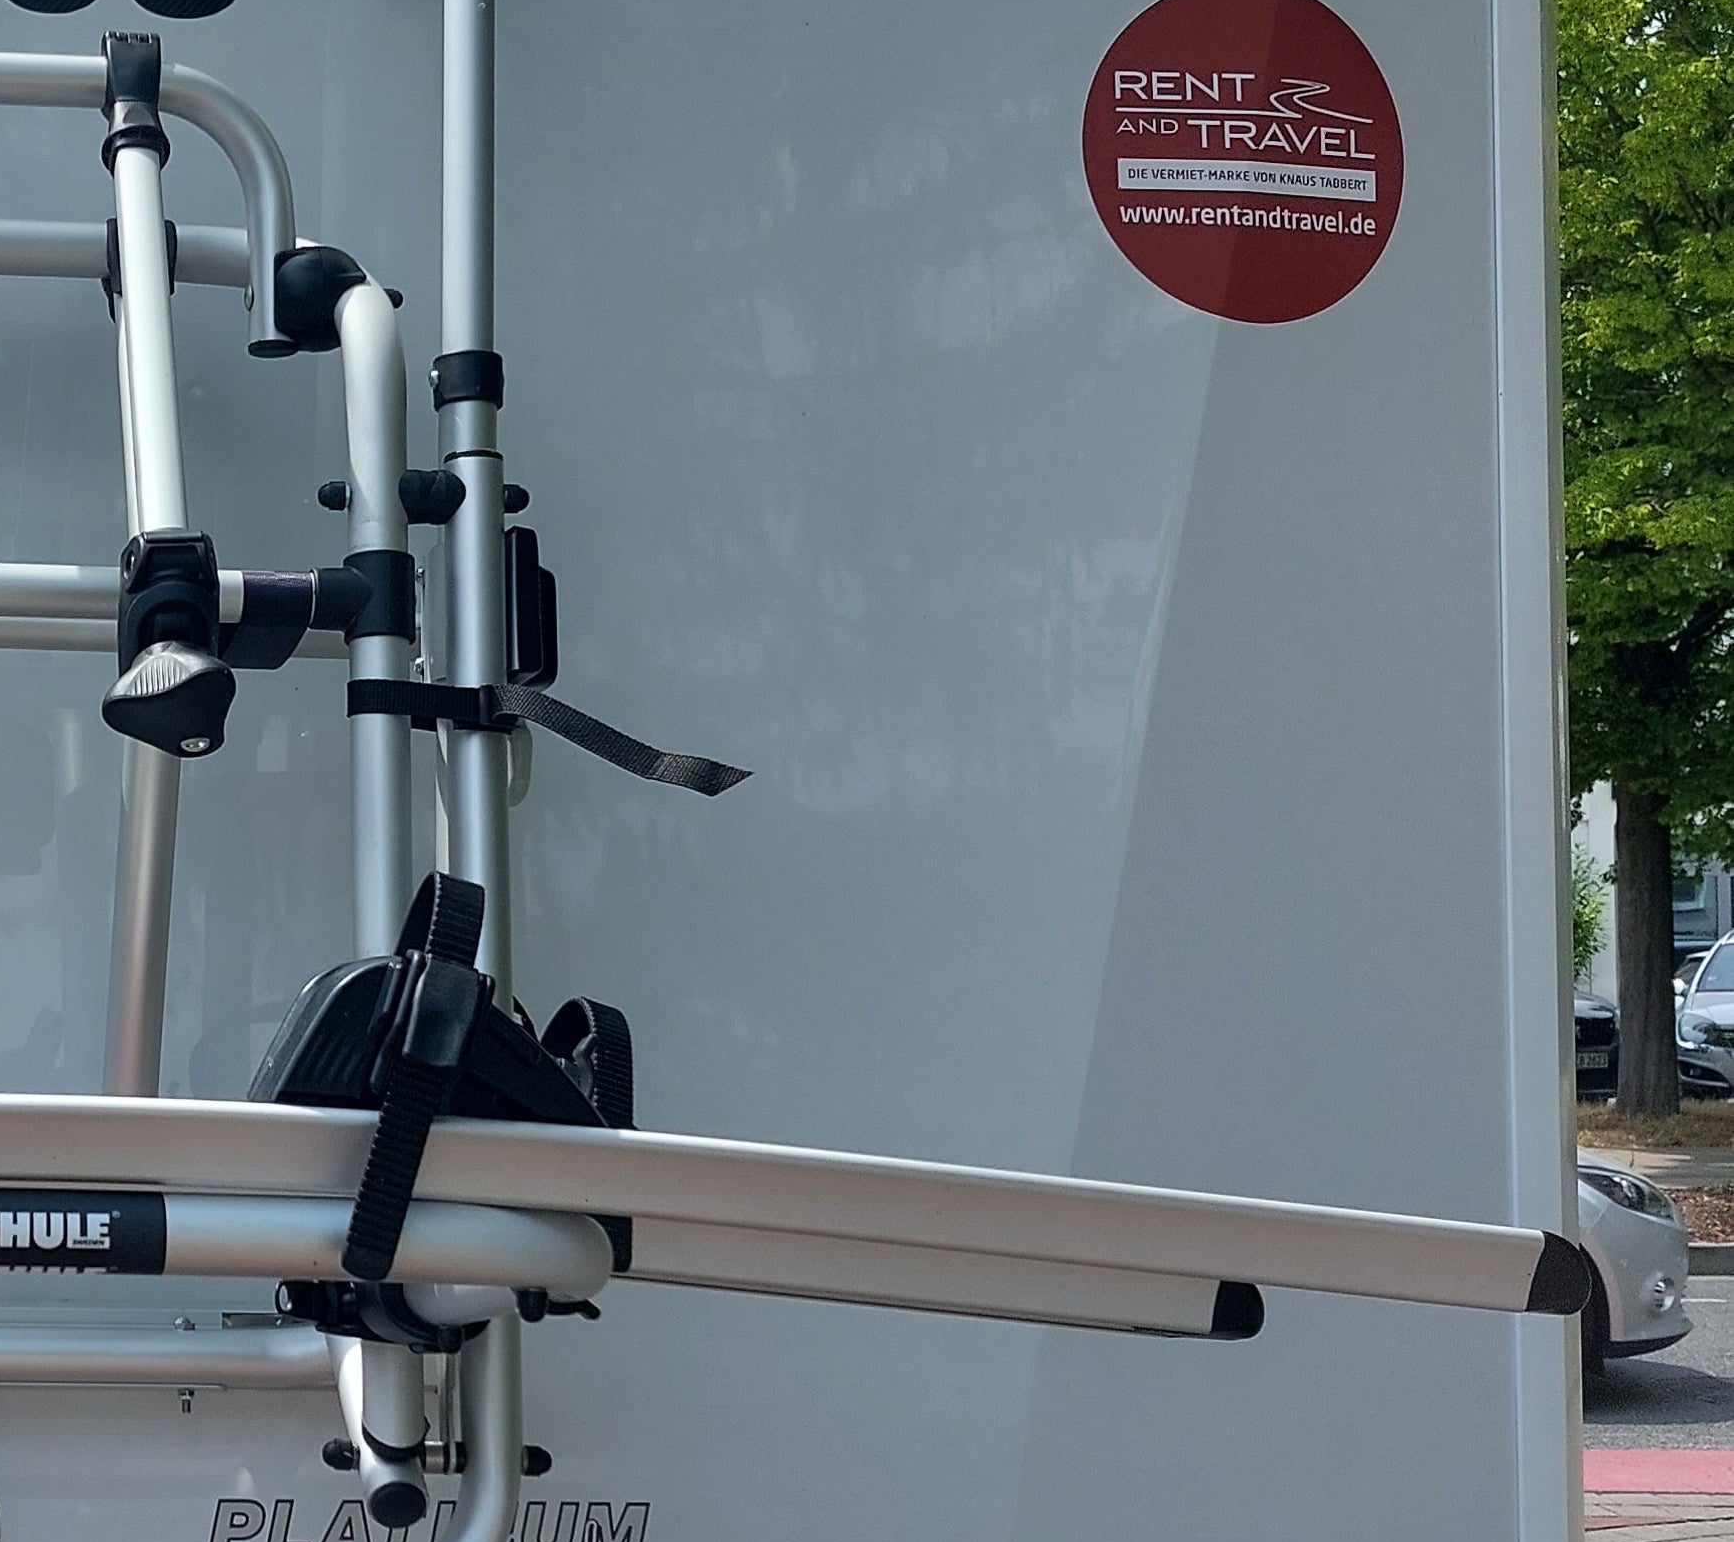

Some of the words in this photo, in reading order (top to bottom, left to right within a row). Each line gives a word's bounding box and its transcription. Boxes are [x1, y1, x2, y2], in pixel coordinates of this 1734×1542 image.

[1115, 70, 1256, 103] RENT
[1116, 117, 1180, 135] AND
[1187, 119, 1376, 160] TRAVEL
[1127, 167, 1149, 180] DIE
[1151, 167, 1251, 183] VERMIET-MARKE
[1253, 171, 1277, 185] VON
[1279, 172, 1317, 188] KNAUS
[1319, 176, 1369, 192] TABBERT
[1119, 204, 1377, 236] www.rentandtravel.de
